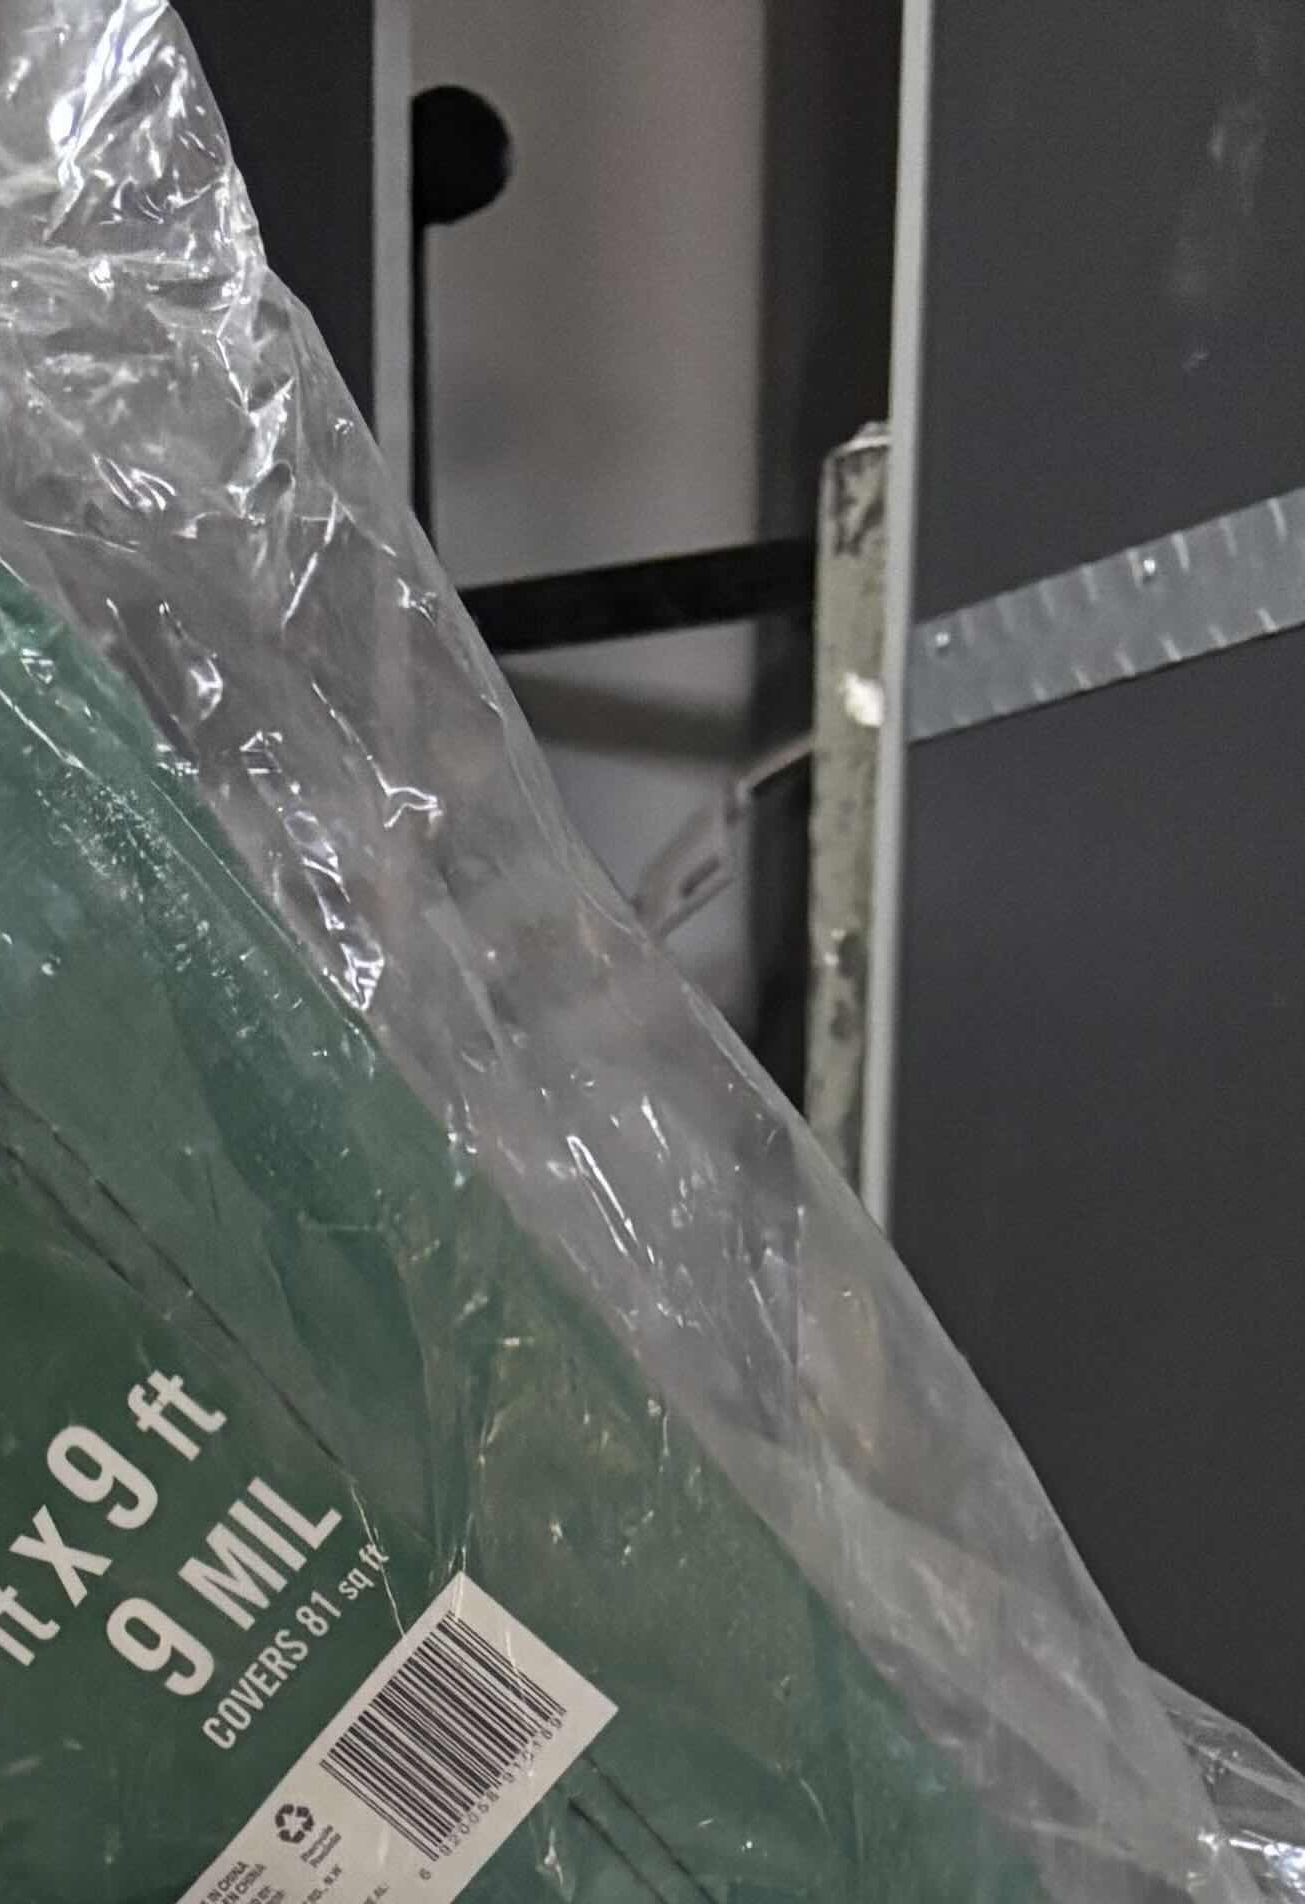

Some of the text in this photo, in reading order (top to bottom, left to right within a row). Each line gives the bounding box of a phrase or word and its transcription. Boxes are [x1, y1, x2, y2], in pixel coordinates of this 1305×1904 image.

[47, 1425, 158, 1529] 9
[127, 1370, 227, 1461] ft
[106, 1477, 343, 1695] 9 MIL
[202, 1543, 389, 1750] COVERS 81 sq ft
[205, 1887, 223, 1904] IN
[215, 1857, 249, 1894] CHINA
[233, 1860, 266, 1896] CHINA
